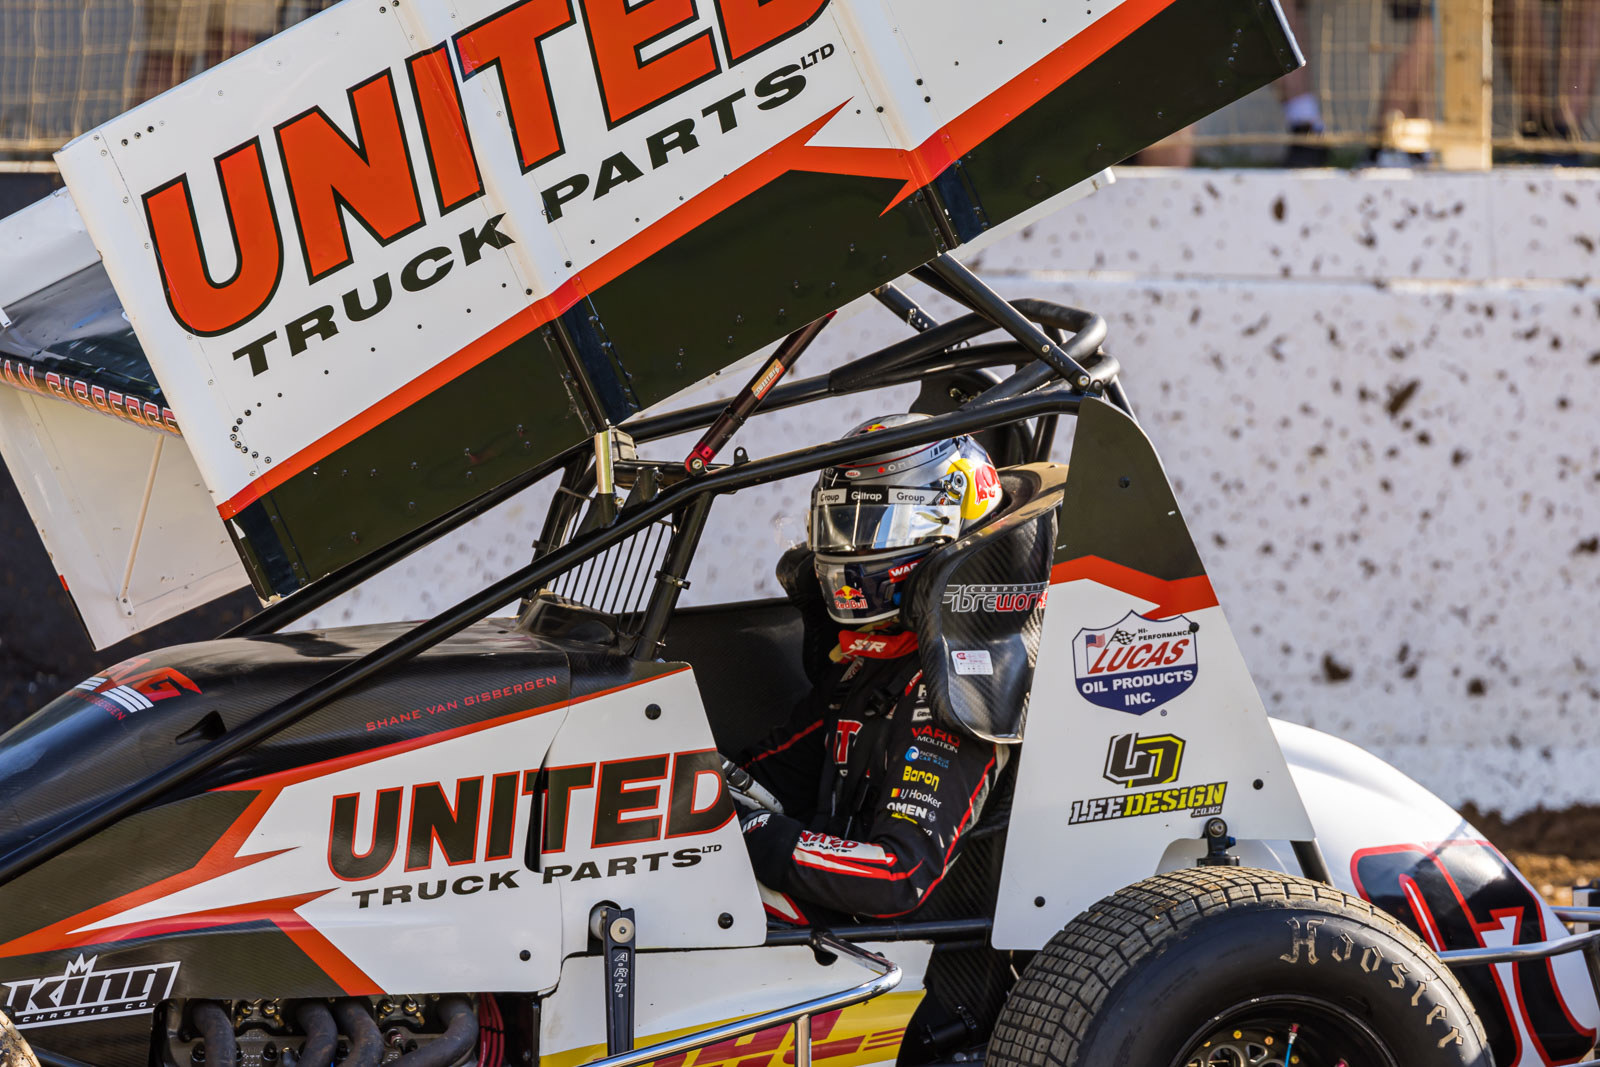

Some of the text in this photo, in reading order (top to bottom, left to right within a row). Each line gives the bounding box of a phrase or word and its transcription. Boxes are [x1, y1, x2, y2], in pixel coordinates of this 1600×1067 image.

[232, 43, 834, 377] TRUCK PARTS LTD
[896, 491, 926, 504] Group
[834, 599, 868, 609] Red Bull
[1138, 630, 1191, 642] PERFORMANCE
[1088, 638, 1190, 675] LUCAS
[1082, 669, 1194, 694] OIL PRODUCTS
[366, 675, 558, 732] SHANE VAN GISBERGEN
[1125, 693, 1156, 706] INC.
[902, 765, 940, 792] Baron
[909, 788, 942, 809] Hooker
[327, 747, 738, 882] UNITED
[352, 844, 722, 909] TRUCK PARTS LTD
[1279, 916, 1465, 1049] Hoosier
[22, 1000, 157, 1023] CHASSIS CO.
